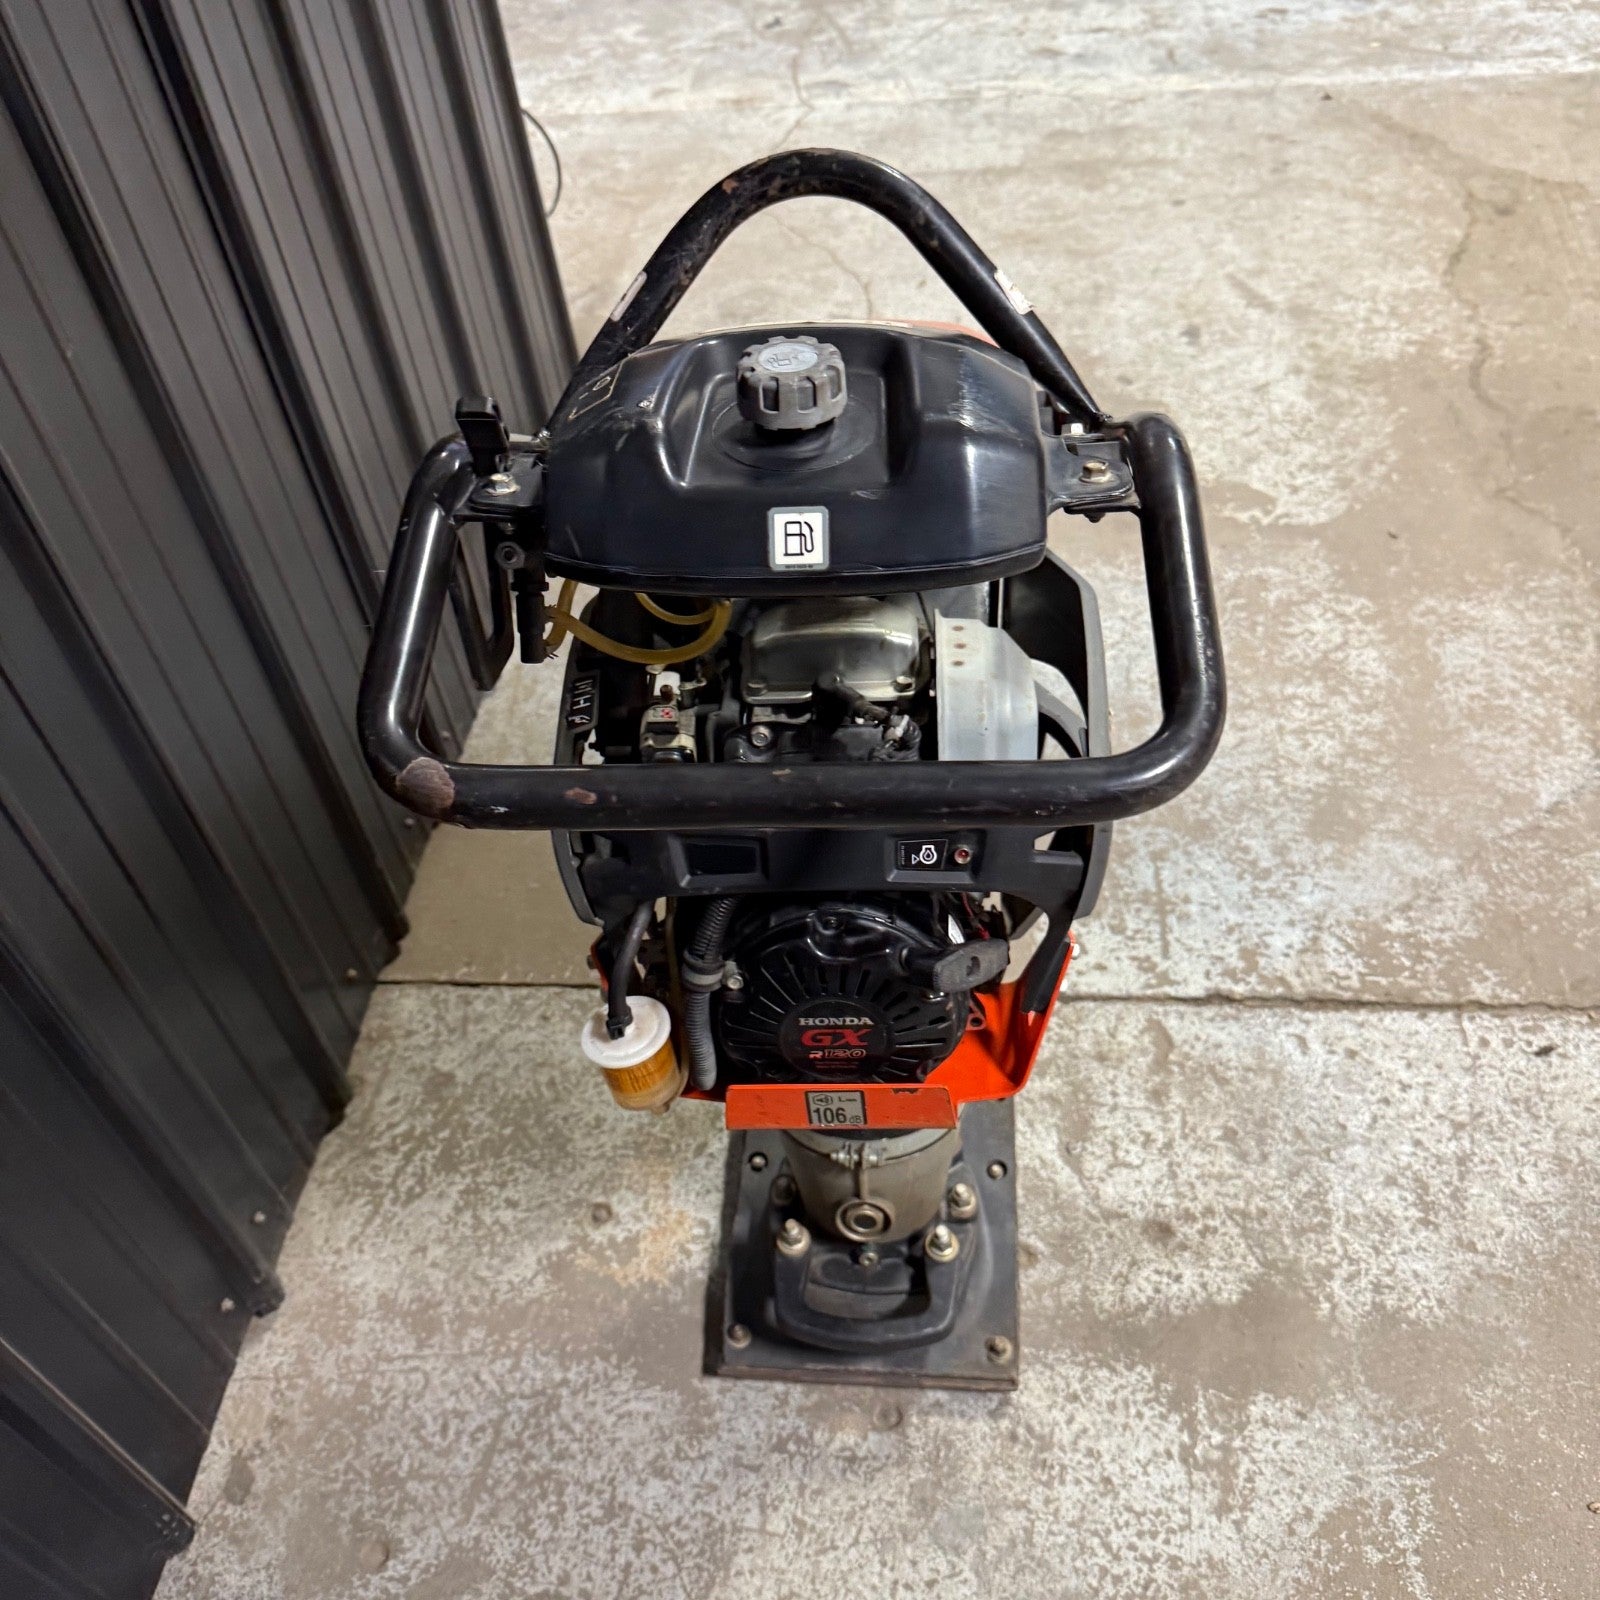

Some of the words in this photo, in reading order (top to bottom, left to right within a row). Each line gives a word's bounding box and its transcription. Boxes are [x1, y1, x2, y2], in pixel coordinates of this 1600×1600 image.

[798, 1017, 874, 1026] HONDA
[801, 1028, 872, 1047] GX
[812, 1107, 847, 1124] 106
[848, 1115, 862, 1124] dB
